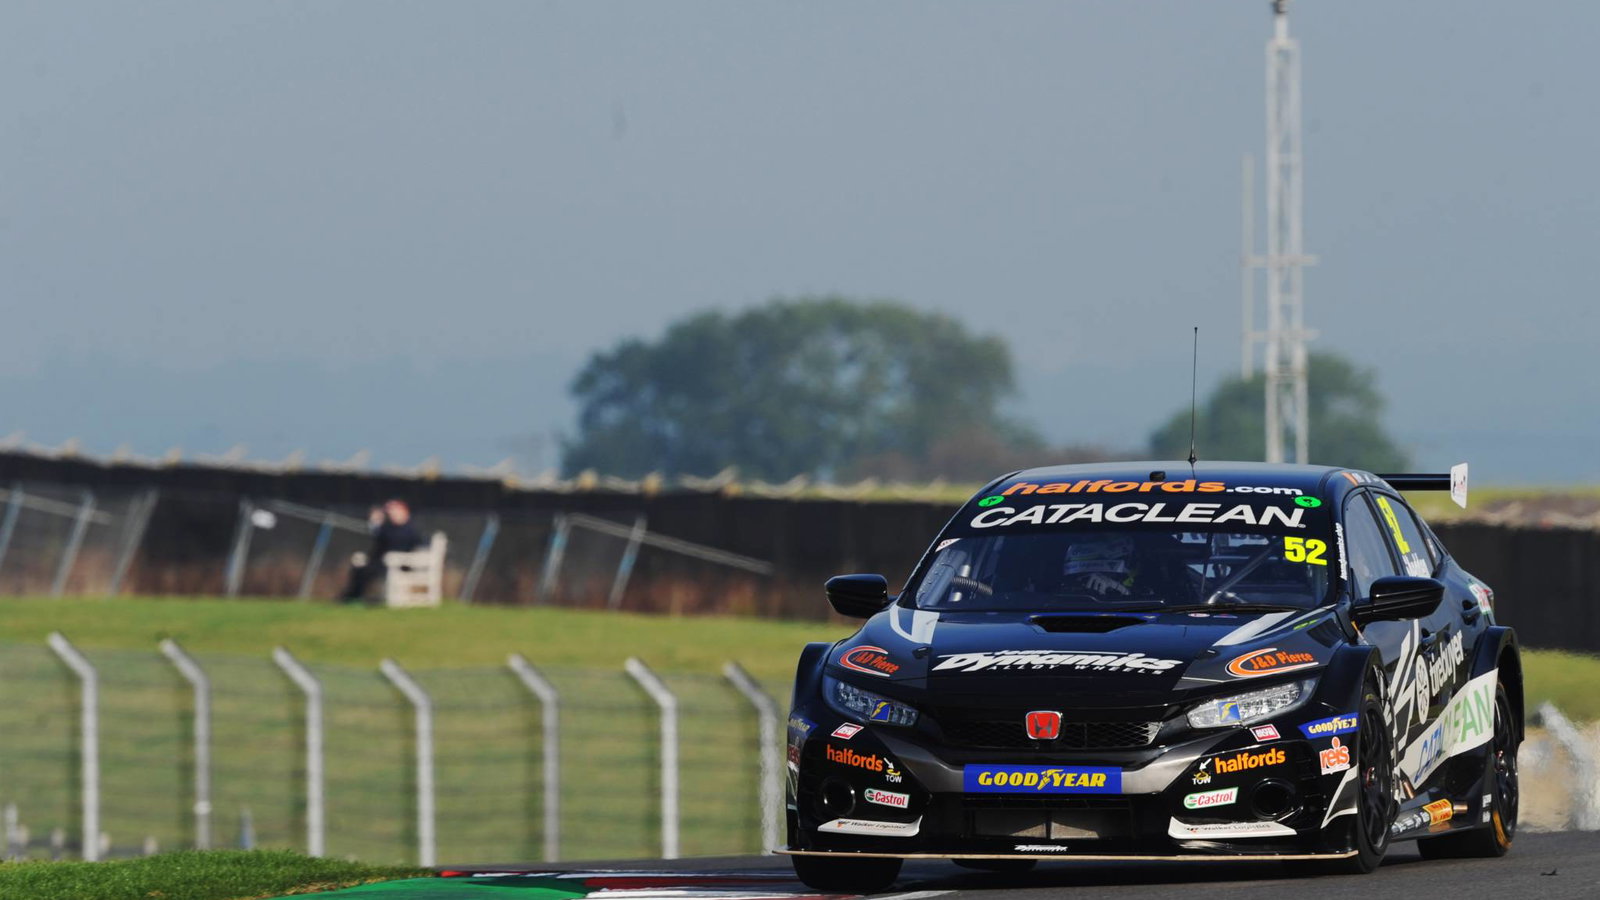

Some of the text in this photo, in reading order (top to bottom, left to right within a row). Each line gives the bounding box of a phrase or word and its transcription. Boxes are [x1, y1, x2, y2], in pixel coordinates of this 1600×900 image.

[1001, 479, 1304, 496] halfords.com
[970, 502, 1305, 528] CATACLEAN
[1284, 536, 1328, 566] 52
[1251, 650, 1315, 670] J&D Pierce
[1429, 629, 1464, 697] tirebuyer
[1308, 717, 1357, 734] GOODYEAR
[827, 744, 883, 771] halfords
[1215, 749, 1286, 774] halfords
[1320, 737, 1349, 768] reis
[885, 774, 902, 783] TOW
[978, 769, 1107, 790] GOODYEAR
[1192, 776, 1211, 785] TOW
[875, 792, 906, 806] Castrol
[1197, 791, 1233, 806] Castrol
